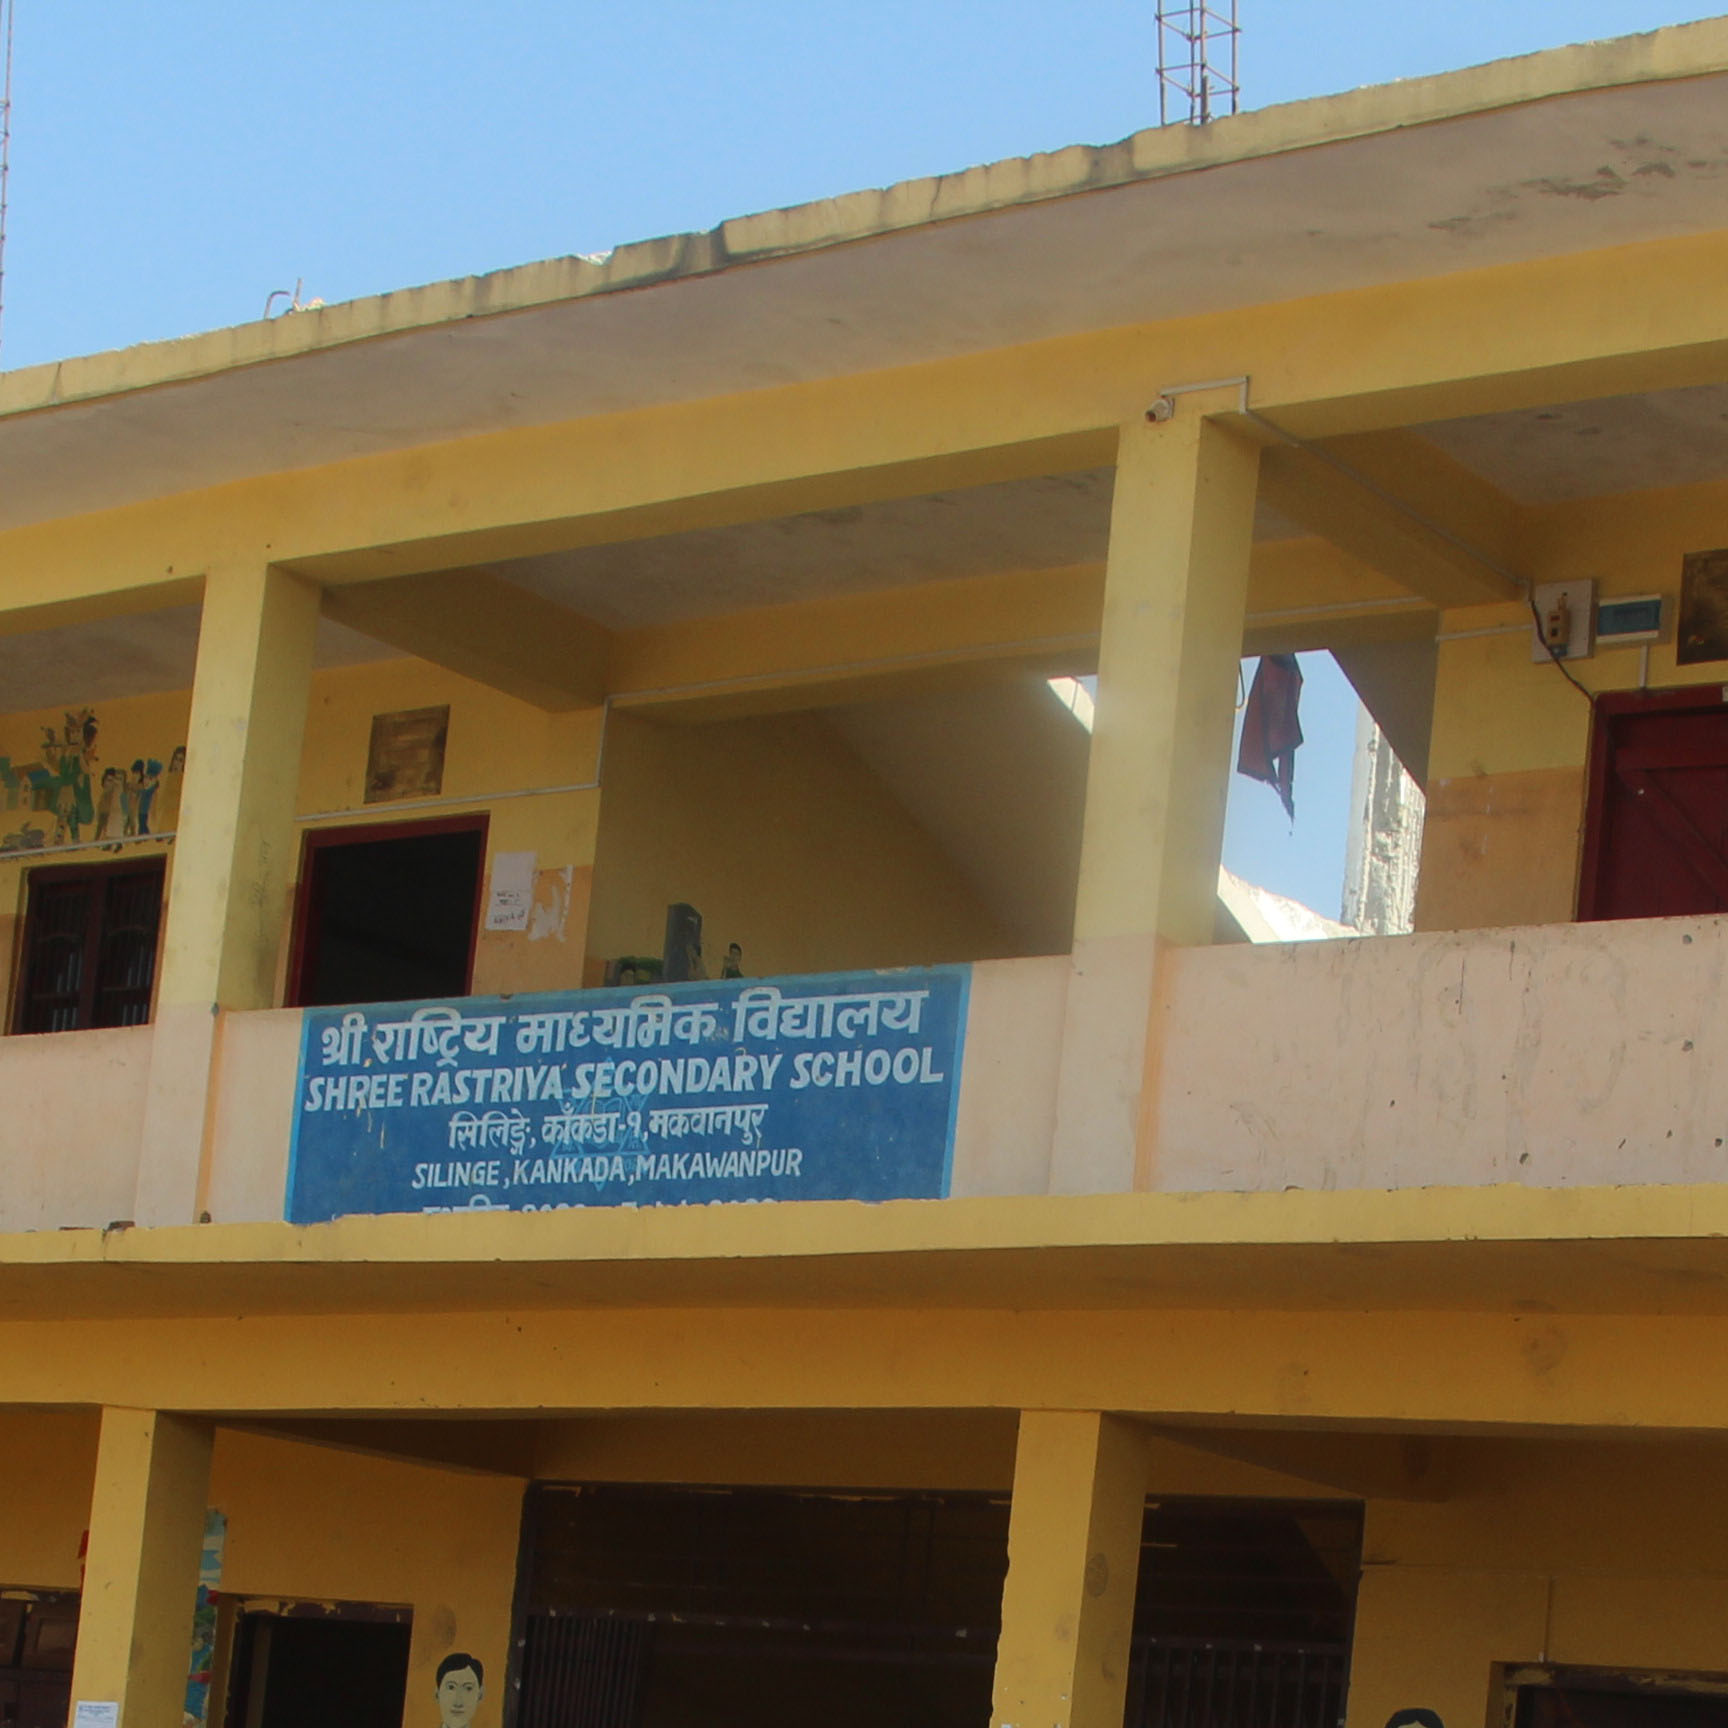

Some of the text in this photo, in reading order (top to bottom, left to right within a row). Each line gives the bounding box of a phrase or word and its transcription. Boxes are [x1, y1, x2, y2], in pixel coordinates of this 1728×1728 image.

[322, 1012, 367, 1066] श्री
[516, 994, 719, 1054] माध्यमिक
[732, 986, 929, 1043] विद्यालय
[304, 1046, 945, 1112] SHREE RASTRIYA SECONDARY SCHOOL
